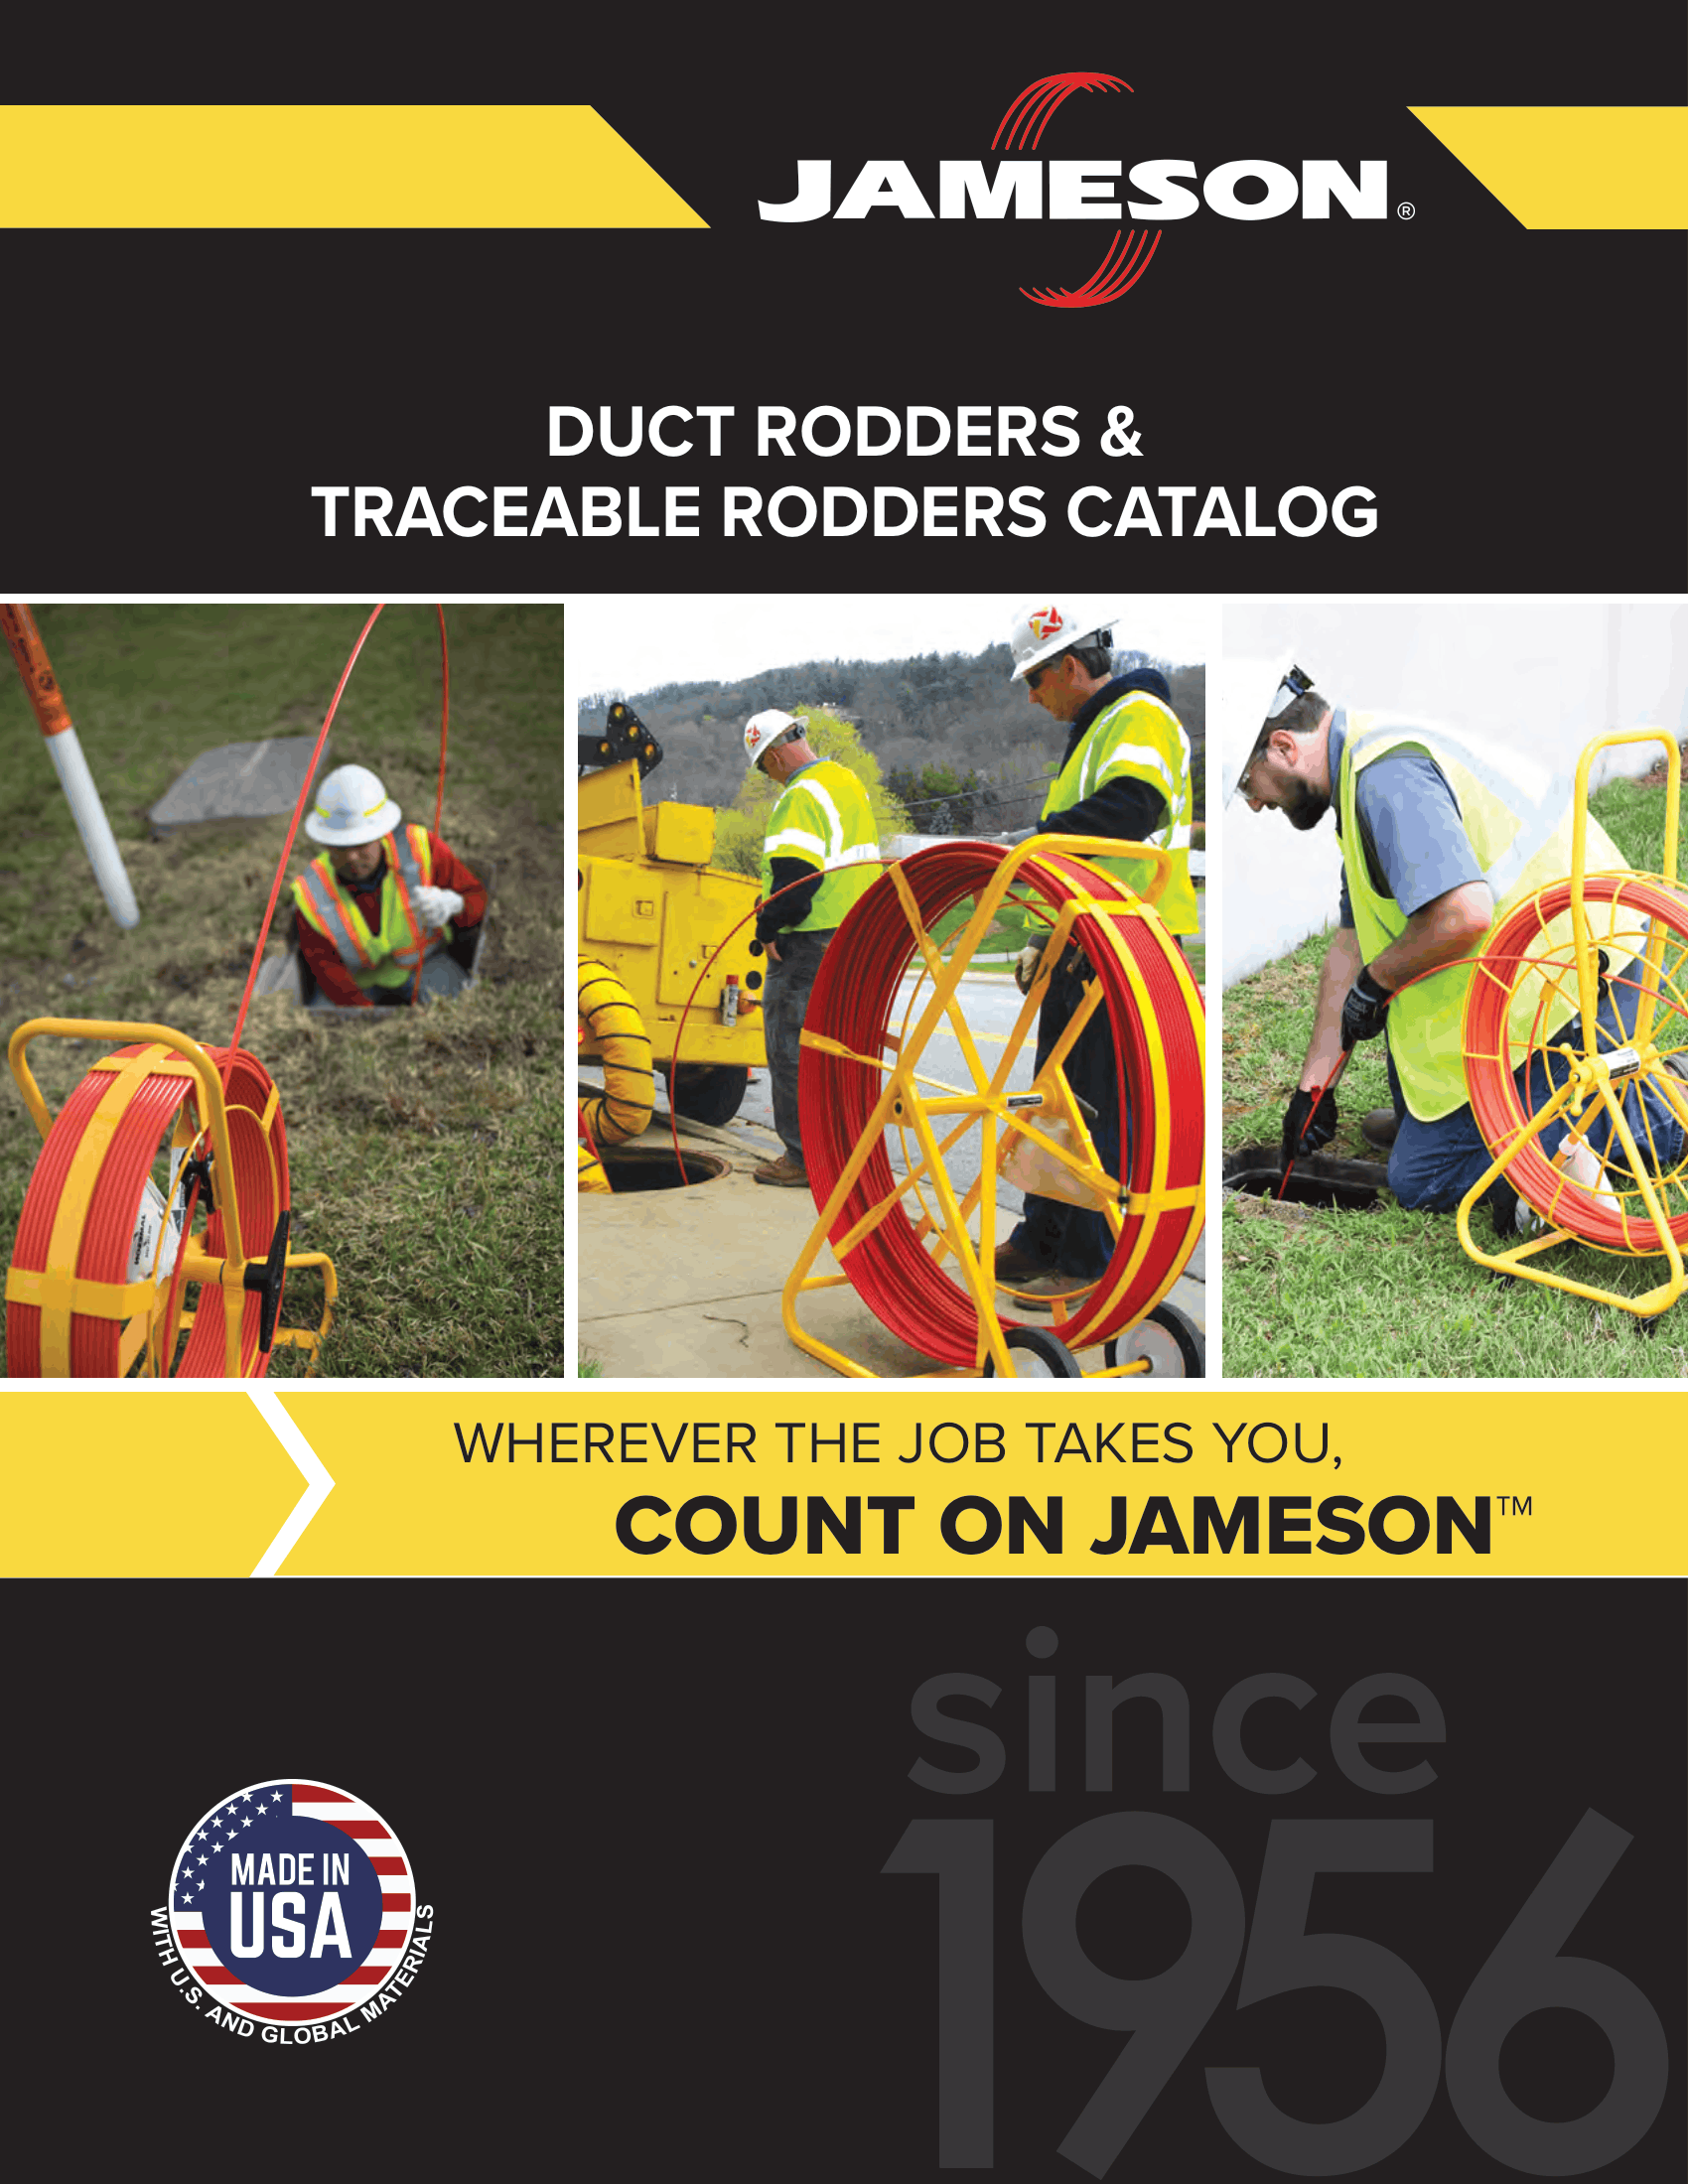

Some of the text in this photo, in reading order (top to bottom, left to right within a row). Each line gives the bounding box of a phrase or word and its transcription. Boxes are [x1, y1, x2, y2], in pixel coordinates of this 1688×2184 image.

[550, 405, 1144, 457] DUCT RODDERS &
[312, 485, 1377, 537] TRACEABLE RODDERS CATALOG
[454, 1423, 1341, 1470] WHEREVER THE JOB TAKES YOU,
[616, 1496, 914, 1555] COUNT
[940, 1496, 1062, 1555] ON
[908, 1626, 1446, 1794] since
[231, 1852, 350, 1885] MADE IN
[230, 1891, 352, 1958] USA
[150, 1903, 435, 2045] WITH U.S. AND GLOBAL MATERIALS
[881, 1807, 1668, 2181] 1956
